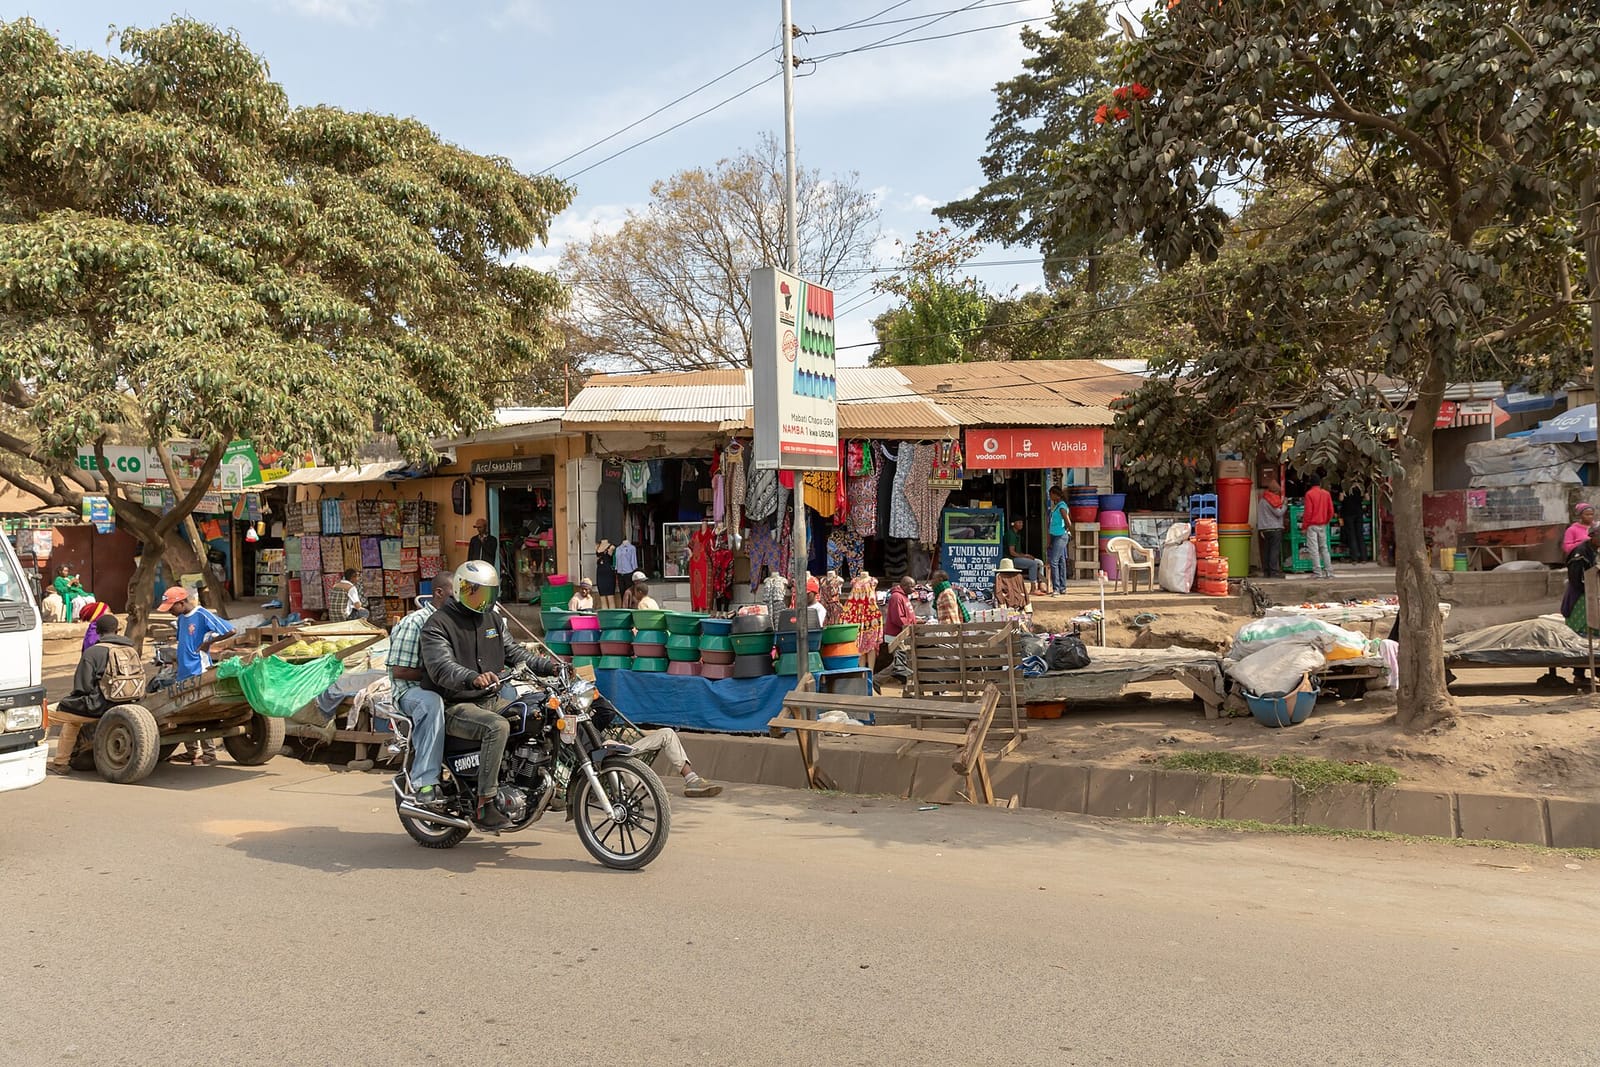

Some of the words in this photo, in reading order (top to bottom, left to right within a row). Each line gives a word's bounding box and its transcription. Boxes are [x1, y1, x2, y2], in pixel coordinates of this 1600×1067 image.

[791, 413, 807, 423] Mabati
[823, 417, 834, 426] GSM
[782, 424, 805, 435] NAMBA
[819, 430, 834, 438] UBORA
[1051, 440, 1087, 451] Wakala
[117, 456, 141, 473] CO
[948, 545, 976, 556] FUNDI
[976, 546, 999, 557] SIMU
